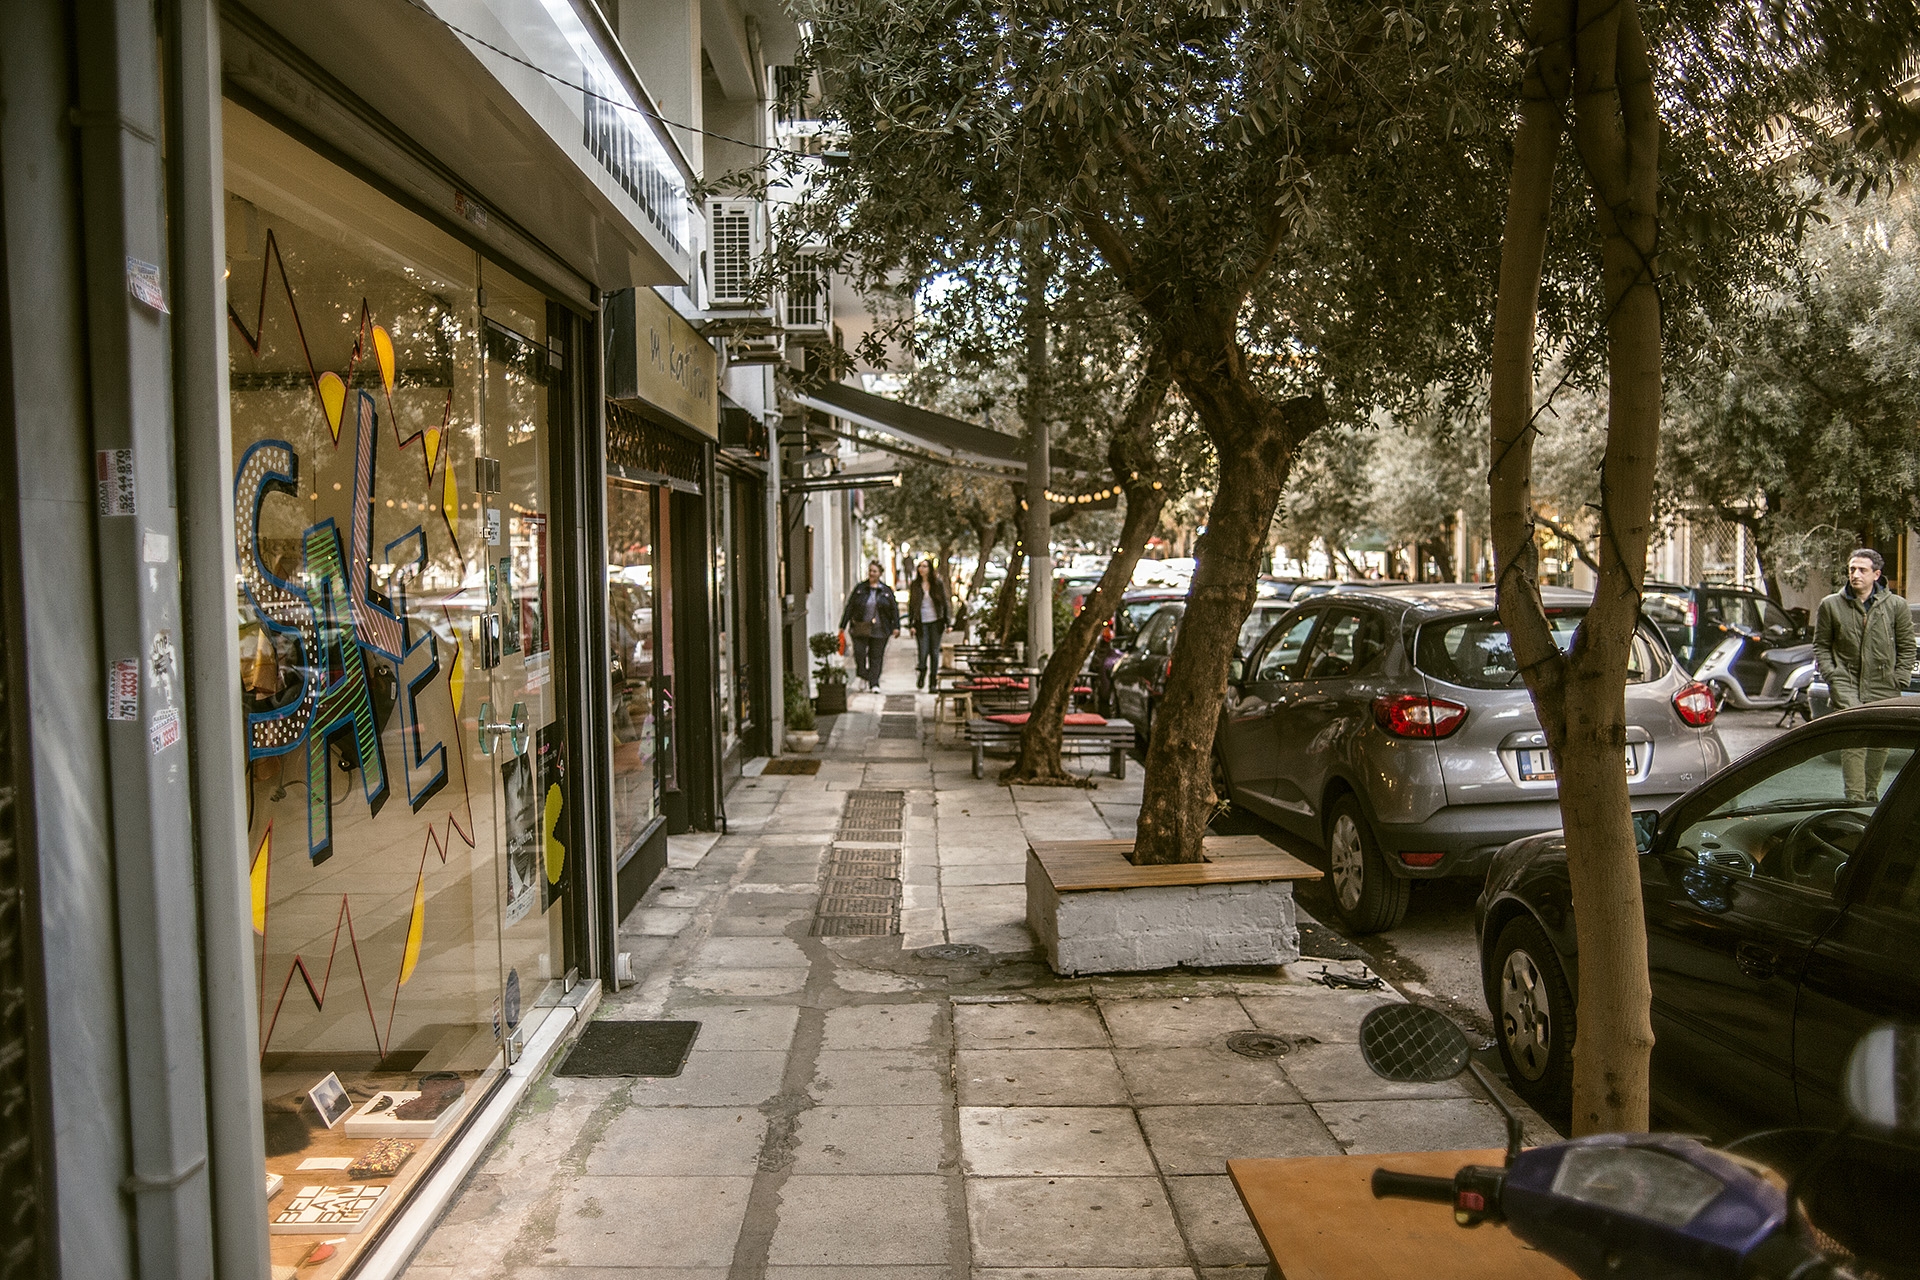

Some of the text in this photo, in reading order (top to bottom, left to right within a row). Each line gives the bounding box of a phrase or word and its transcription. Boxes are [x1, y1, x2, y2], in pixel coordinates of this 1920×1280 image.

[116, 450, 125, 473] 870
[234, 389, 448, 866] SALE
[120, 672, 138, 717] 751.3333
